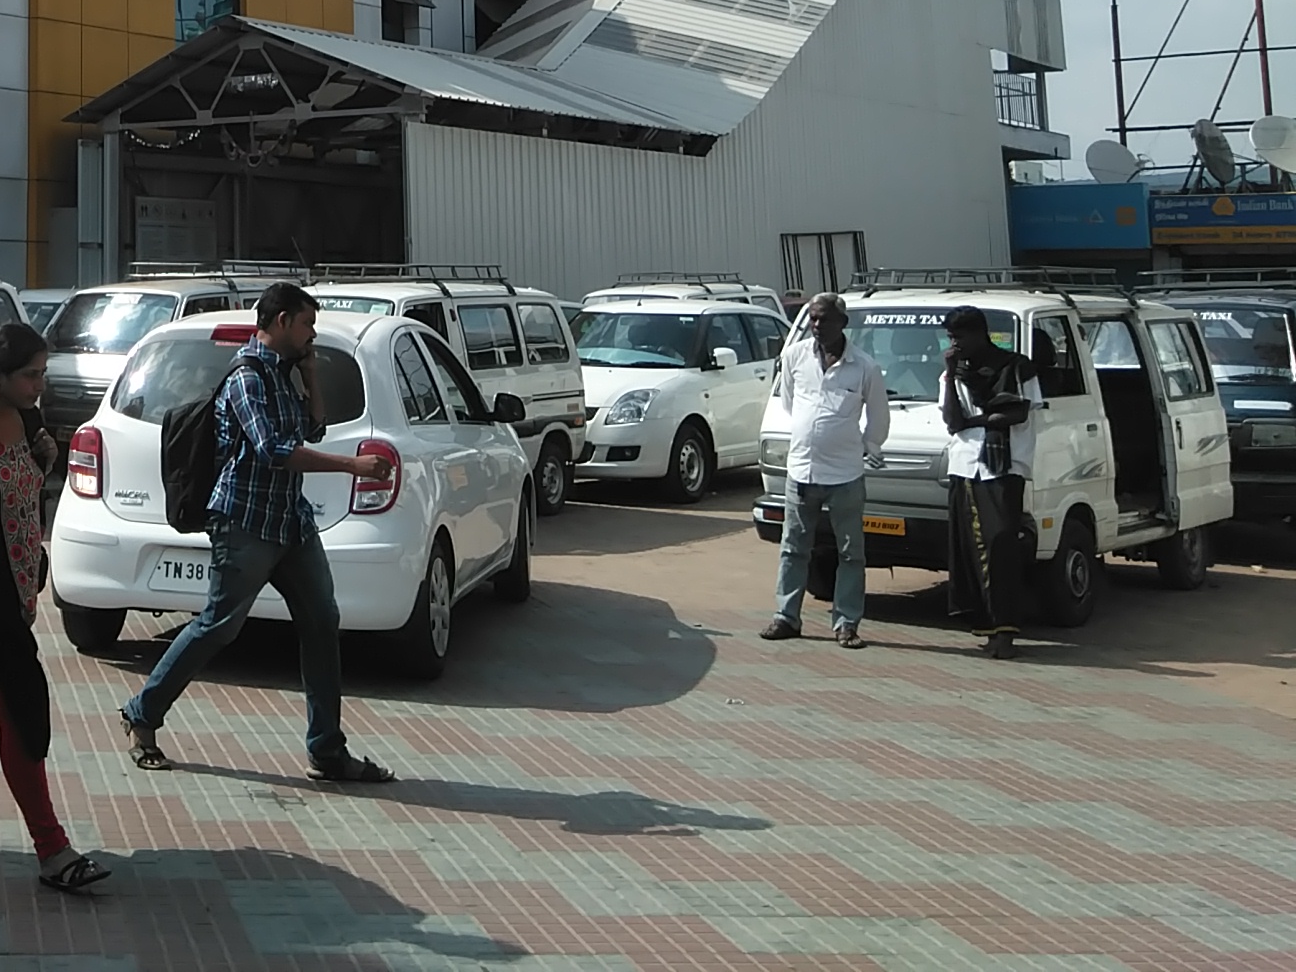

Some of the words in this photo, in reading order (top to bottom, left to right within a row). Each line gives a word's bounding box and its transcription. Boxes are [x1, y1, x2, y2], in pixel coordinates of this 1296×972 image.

[1269, 198, 1294, 211] Bank
[863, 314, 916, 325] METER
[1200, 312, 1232, 320] TAXI
[163, 561, 183, 579] TN
[186, 563, 204, 580] 38
